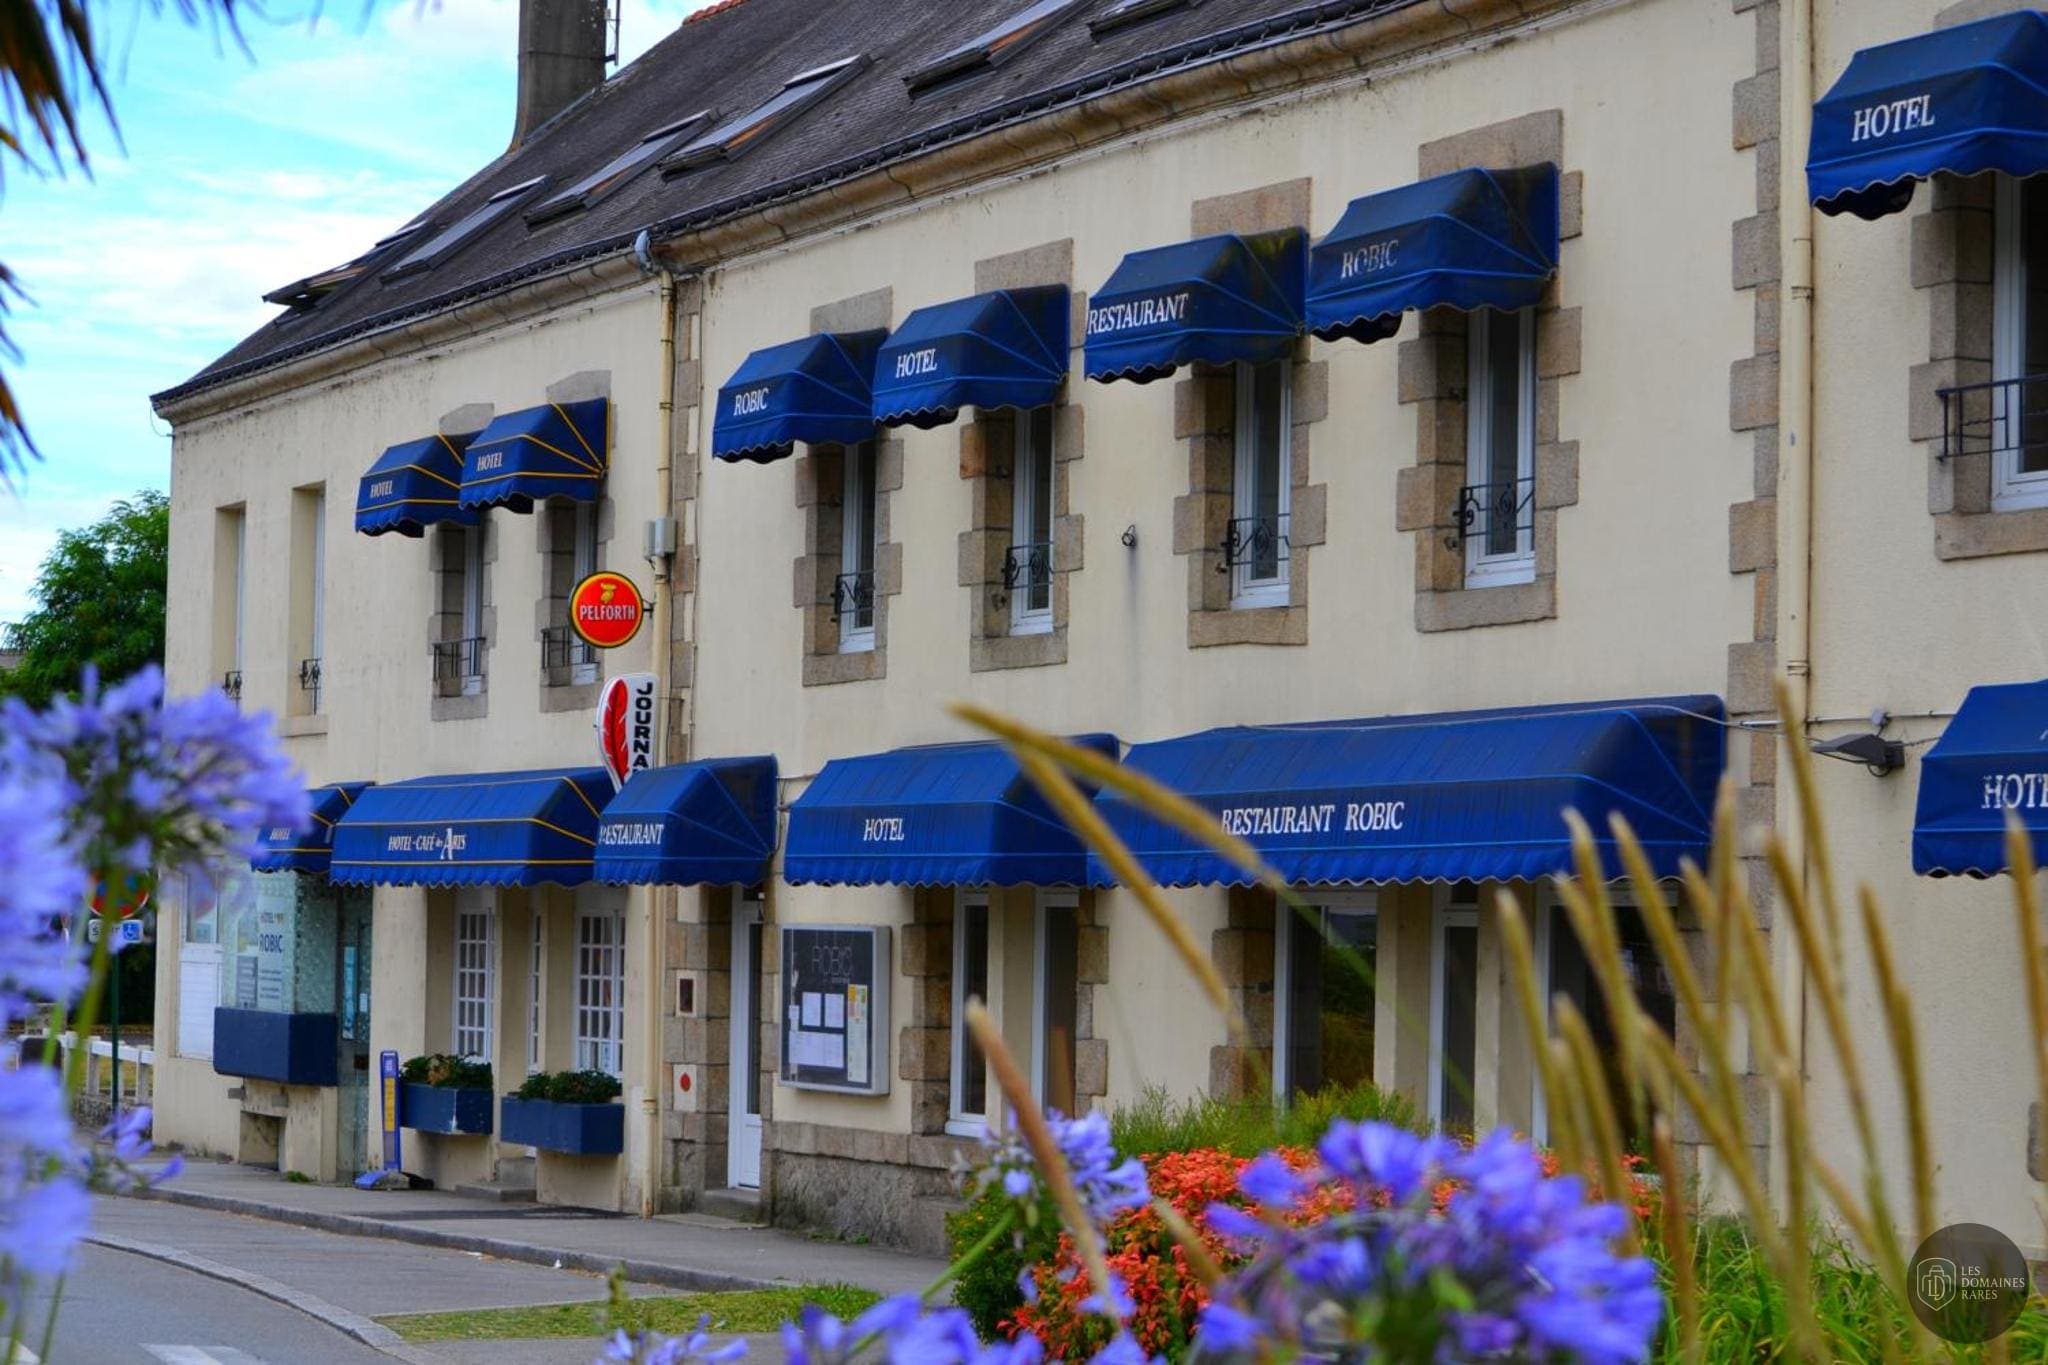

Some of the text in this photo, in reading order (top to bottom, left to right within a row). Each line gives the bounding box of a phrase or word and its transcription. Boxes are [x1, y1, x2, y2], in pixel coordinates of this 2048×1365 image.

[1851, 94, 1935, 142] HOTEL
[1340, 239, 1399, 278] ROBIC
[1087, 293, 1189, 335] RESTAURANT
[895, 348, 938, 379] HOTEL
[733, 387, 770, 416] ROBIC
[475, 452, 503, 472] HOTEL
[369, 480, 393, 499] HOTEL
[580, 604, 636, 620] PELFORTH
[633, 682, 654, 772] JOURNA
[863, 818, 905, 841] HOTEL
[1221, 801, 1405, 836] RESTAURANT ROBIC
[440, 827, 467, 860] ARTS
[598, 823, 665, 846] RESTAURANT
